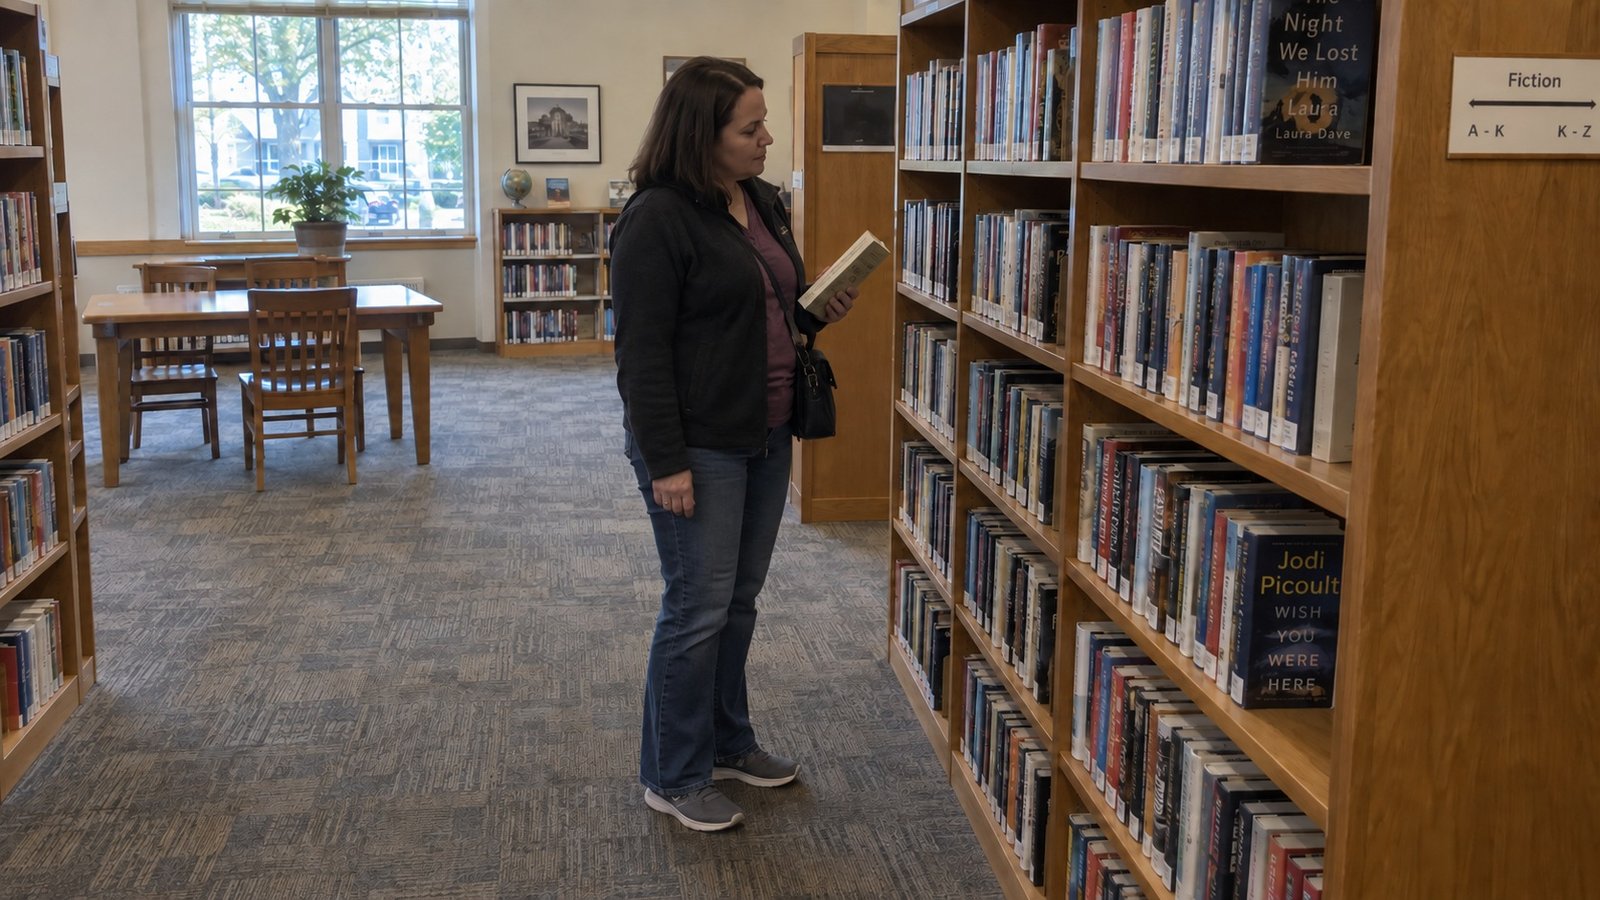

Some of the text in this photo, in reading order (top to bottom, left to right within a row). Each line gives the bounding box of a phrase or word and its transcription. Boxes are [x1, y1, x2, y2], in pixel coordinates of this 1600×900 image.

[1284, 12, 1344, 38] Night
[1280, 42, 1359, 61] We Lost
[1296, 71, 1338, 89] Him
[1508, 72, 1562, 88] Fiction
[1288, 98, 1338, 116] Laura
[1275, 127, 1351, 139] Laura Dave
[1277, 550, 1325, 570] Jodi
[1260, 575, 1340, 595] Picoult
[1275, 605, 1321, 619] WISH
[1277, 629, 1315, 643] YOU
[1268, 654, 1319, 667] WERE
[1268, 678, 1316, 691] HERE
